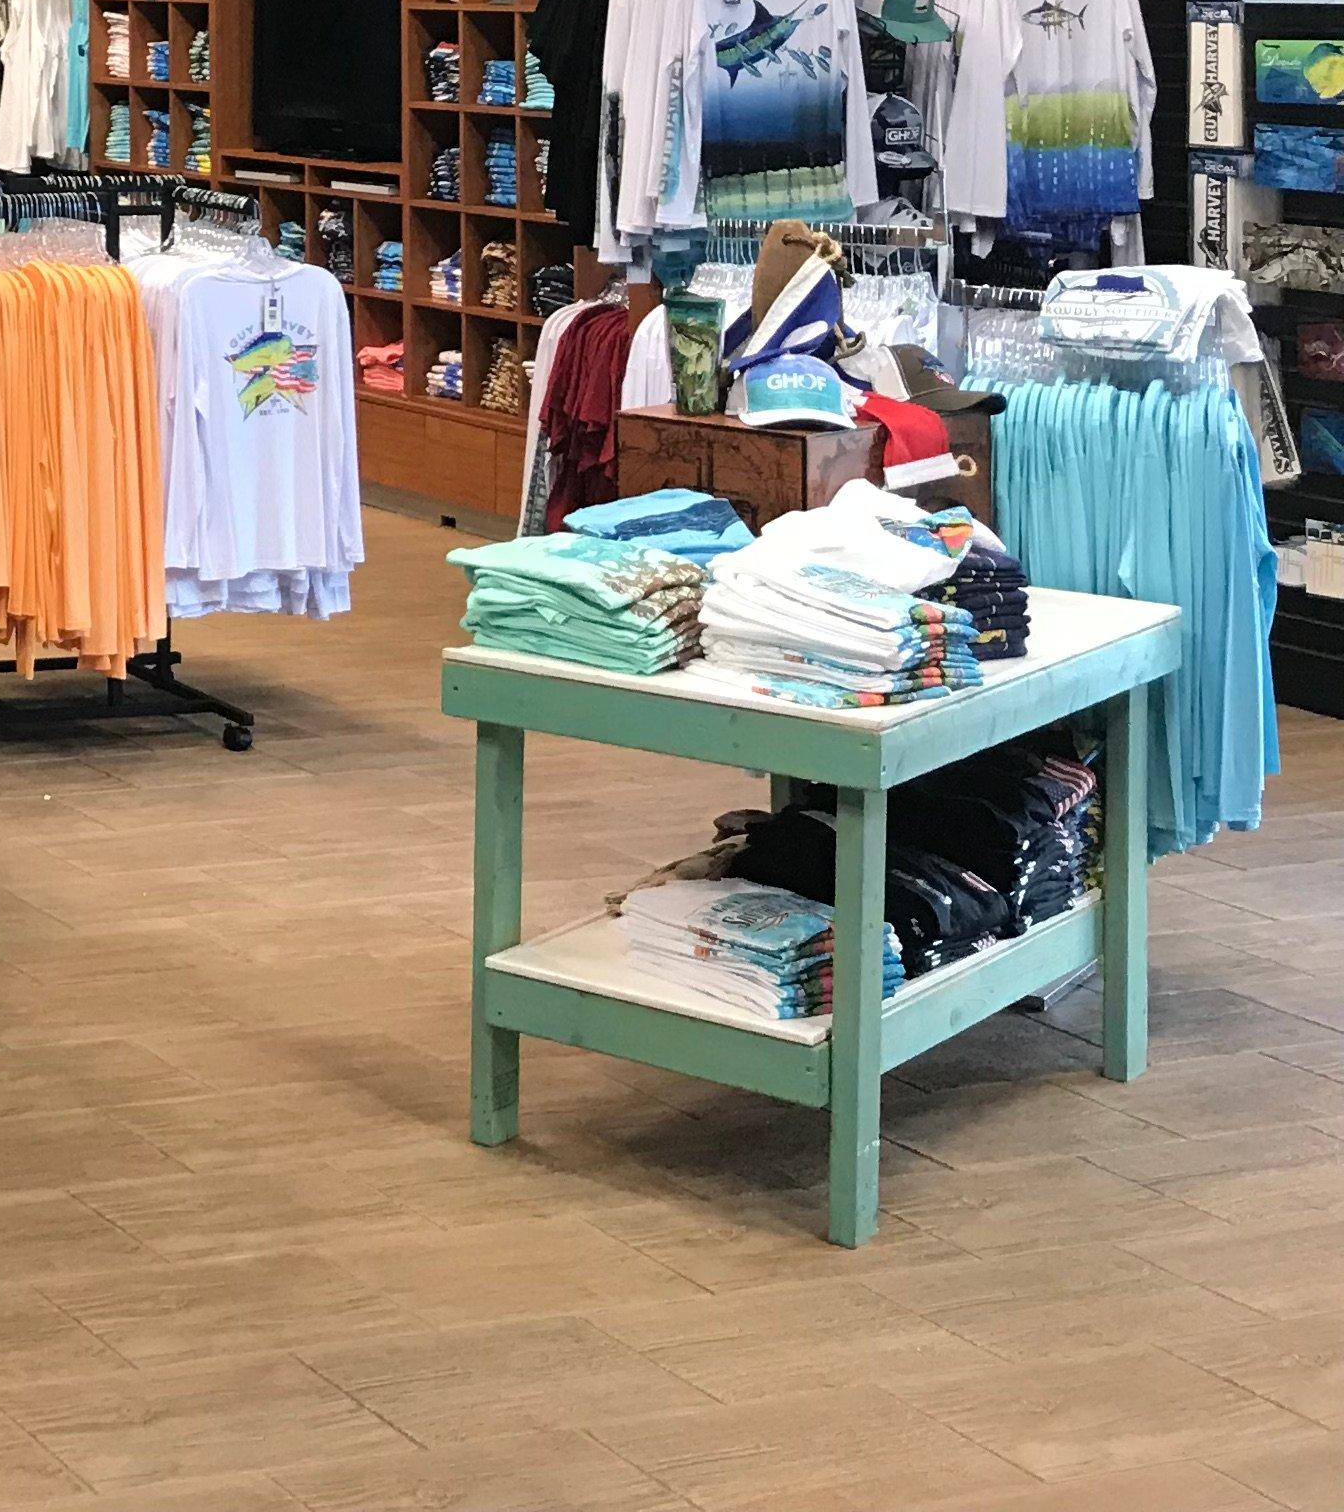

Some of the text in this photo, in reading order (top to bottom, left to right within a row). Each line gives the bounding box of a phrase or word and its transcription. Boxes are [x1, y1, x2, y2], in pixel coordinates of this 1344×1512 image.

[1206, 23, 1219, 83] HARVEY
[1204, 110, 1217, 143] GUY
[1207, 177, 1222, 242] HARVEY
[766, 372, 827, 392] GHOF
